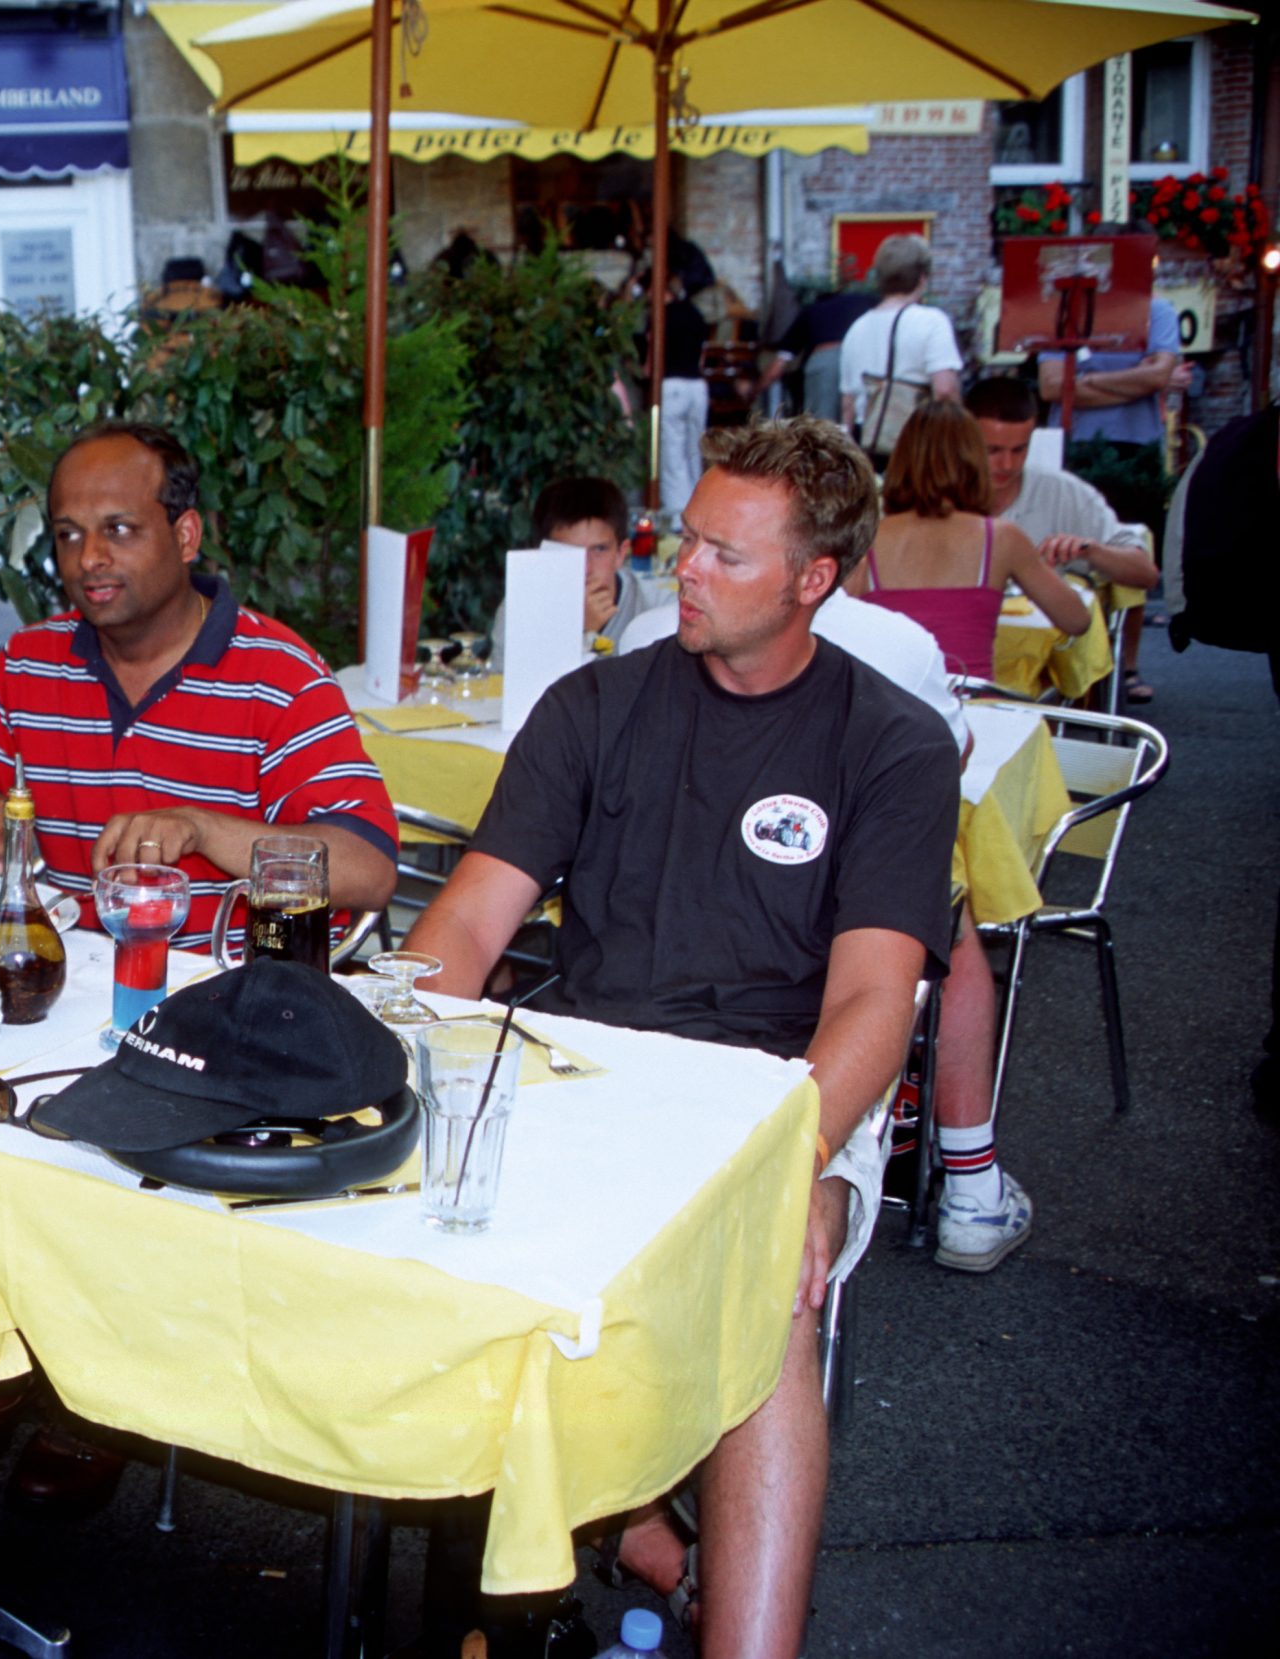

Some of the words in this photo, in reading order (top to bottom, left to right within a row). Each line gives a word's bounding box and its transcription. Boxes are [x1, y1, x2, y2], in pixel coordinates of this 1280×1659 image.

[414, 128, 531, 152] potier
[611, 124, 642, 147] le
[125, 1031, 205, 1072] ERHAM
